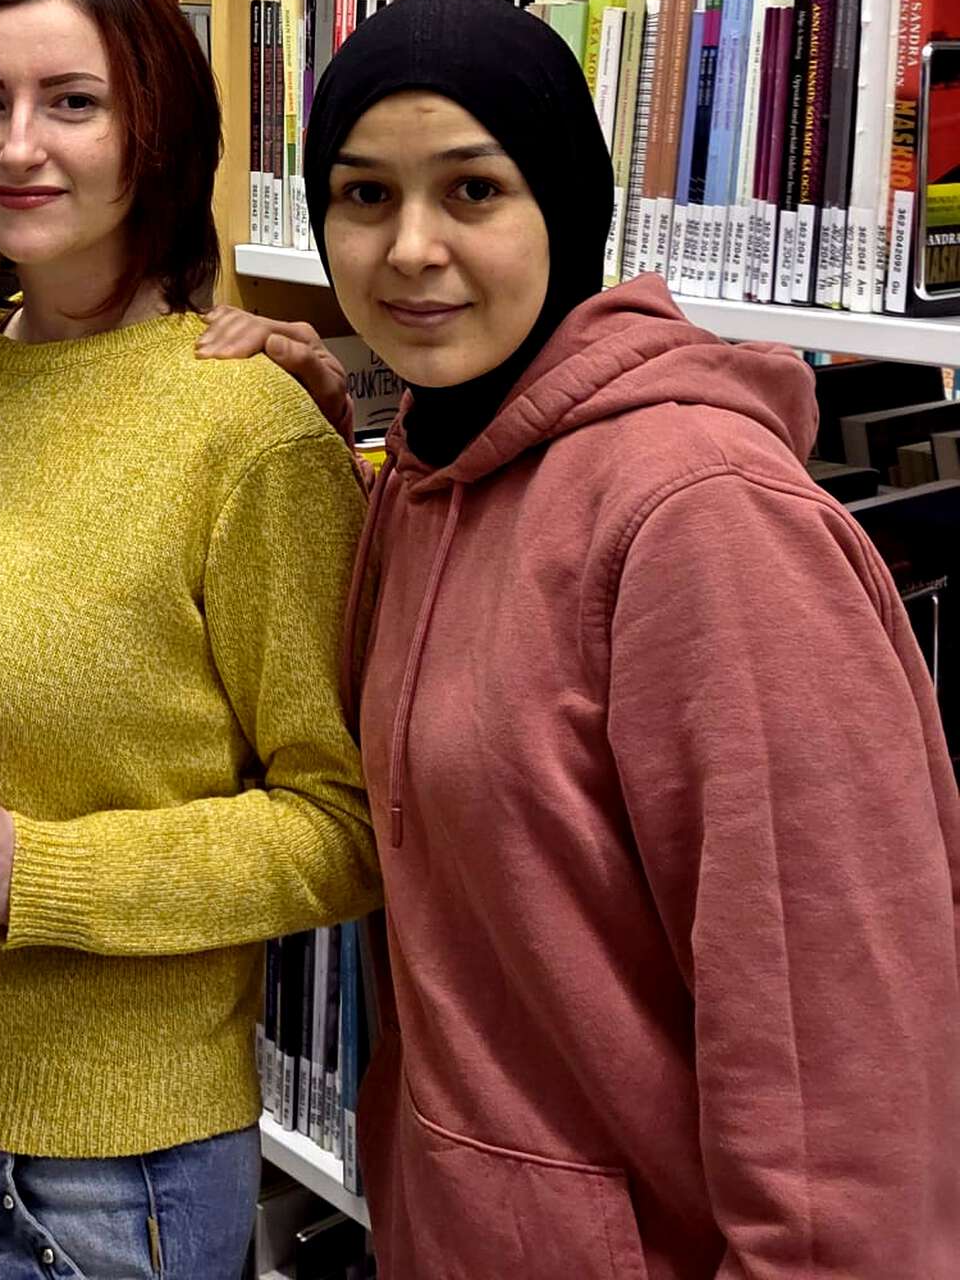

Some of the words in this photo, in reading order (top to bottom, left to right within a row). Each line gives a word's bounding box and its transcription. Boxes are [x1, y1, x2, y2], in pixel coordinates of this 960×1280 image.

[810, 4, 822, 57] ANNLAUG
[907, 2, 923, 66] SANDRA
[805, 106, 815, 130] SOM
[803, 131, 813, 156] MOR
[890, 100, 917, 188] MASKRO
[657, 214, 668, 255] 362.2042
[731, 222, 743, 264] 362.2042
[782, 227, 792, 270] 362.2042
[797, 221, 808, 264] 362.2042
[857, 227, 867, 270] 362.2042
[892, 208, 907, 273] 362.2042092
